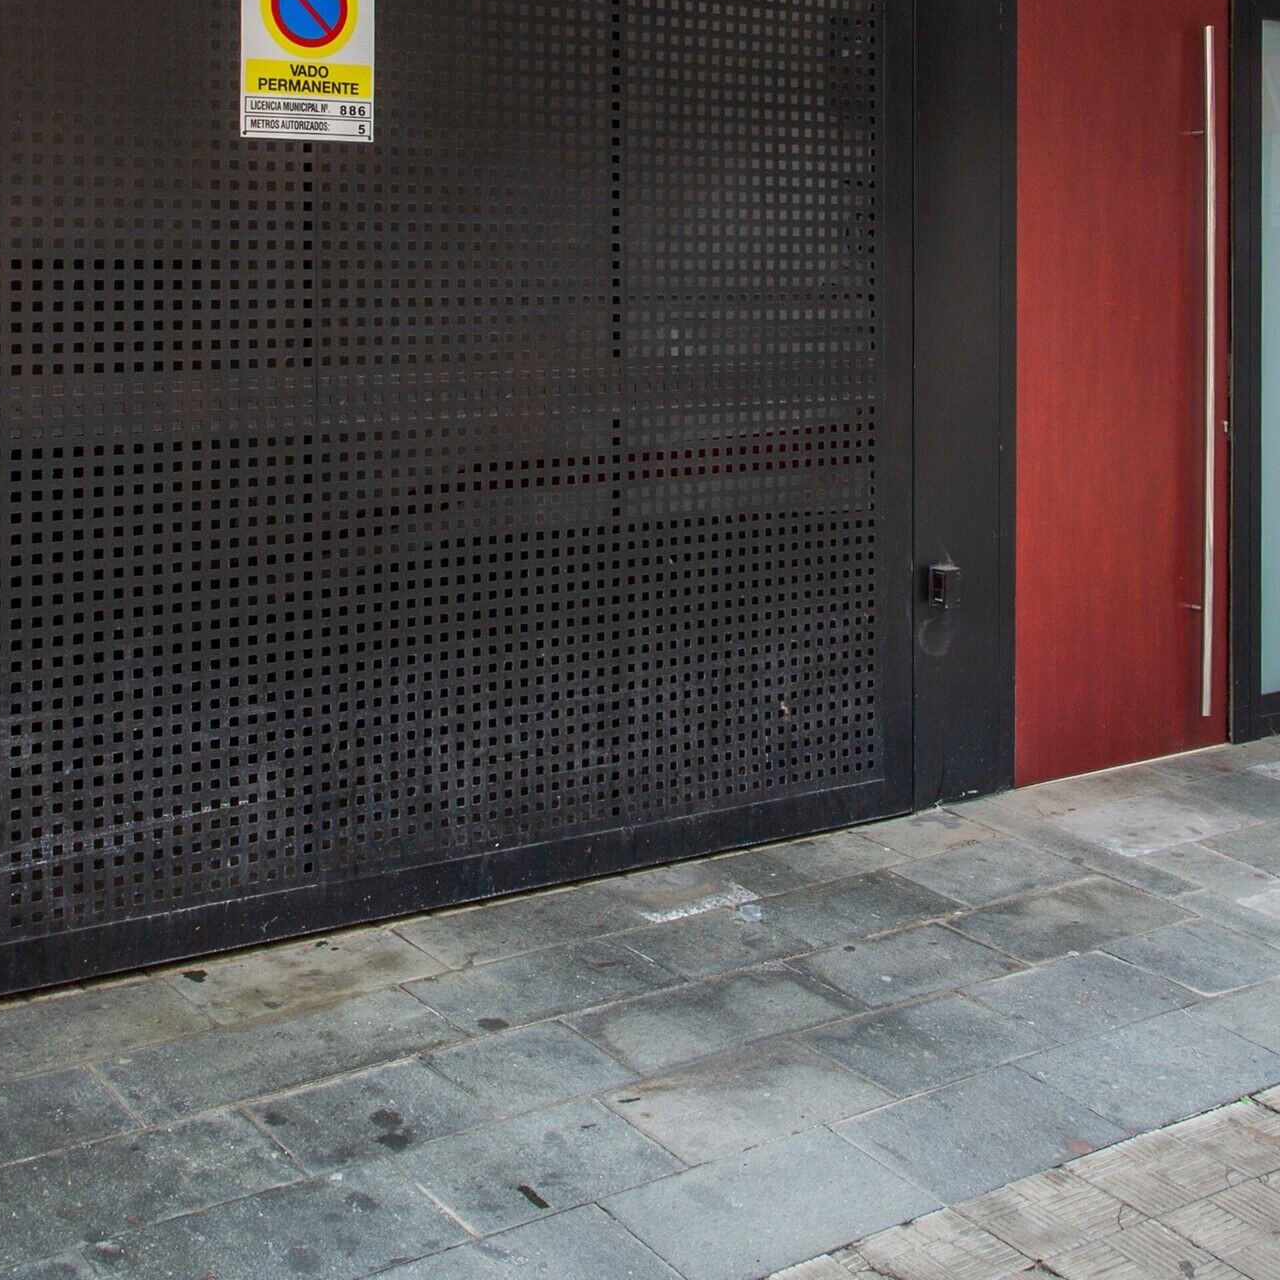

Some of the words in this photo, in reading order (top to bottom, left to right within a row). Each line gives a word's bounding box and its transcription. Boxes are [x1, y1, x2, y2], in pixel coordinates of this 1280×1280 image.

[290, 63, 329, 78] VADO
[258, 77, 359, 95] PERMANENTE
[250, 100, 281, 111] LICENCIA
[282, 102, 319, 113] MUNICIPAL
[340, 105, 366, 117] 886
[250, 118, 280, 129] METROS
[281, 120, 330, 132] AUTORIZADOS:
[358, 124, 366, 135] 5
